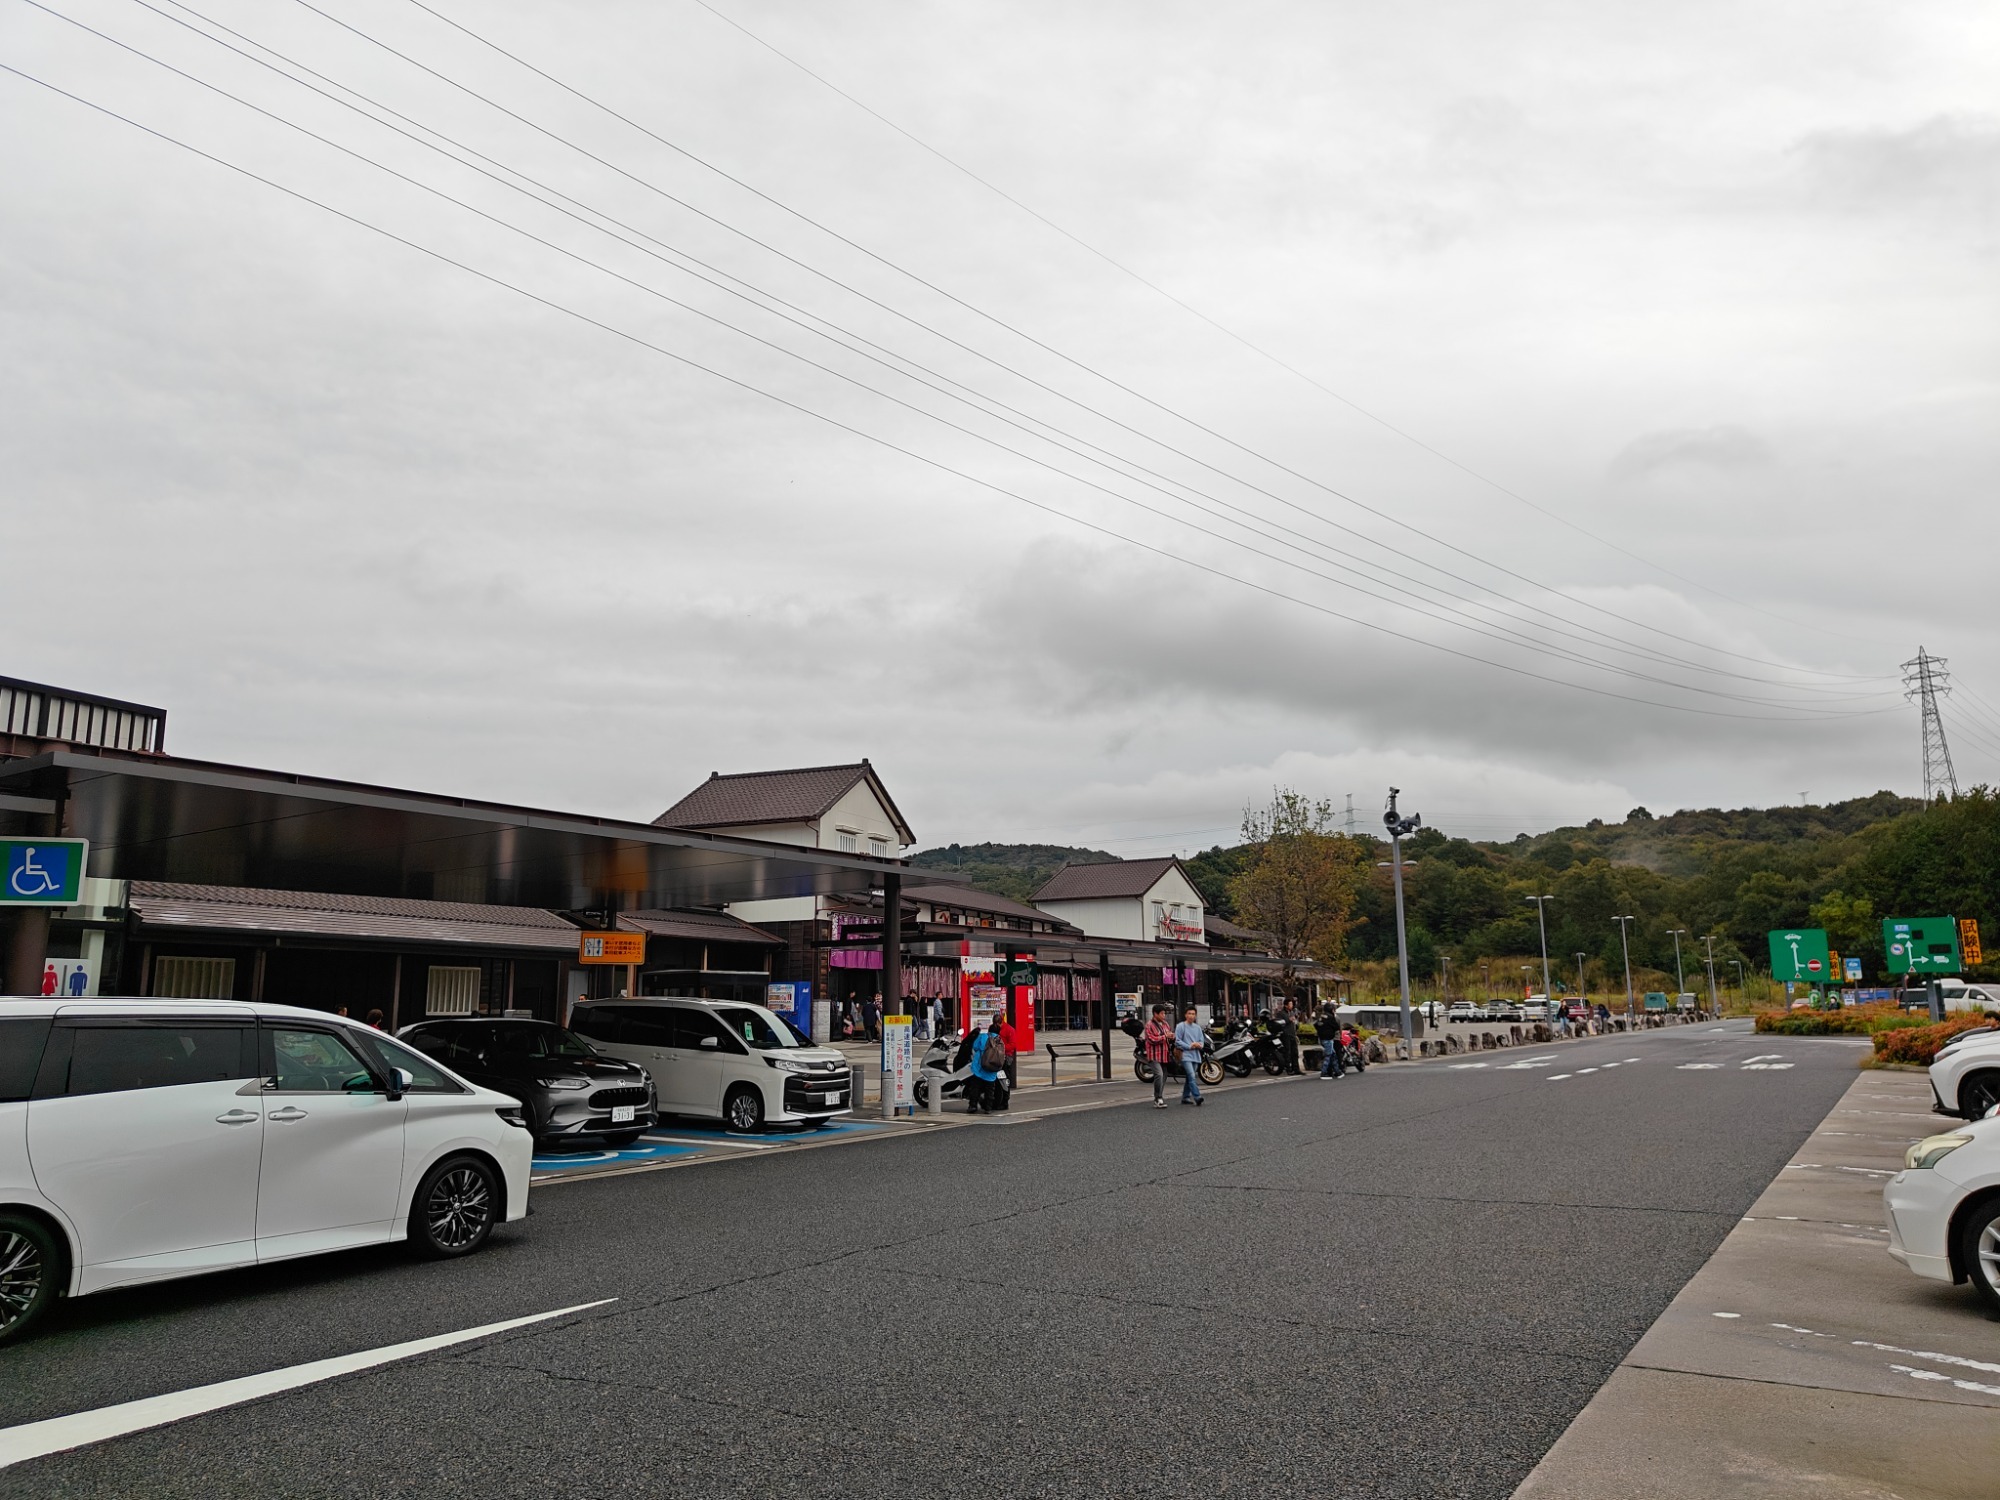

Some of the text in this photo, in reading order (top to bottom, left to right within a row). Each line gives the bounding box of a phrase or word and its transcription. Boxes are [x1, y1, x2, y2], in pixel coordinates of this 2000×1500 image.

[1962, 920, 1980, 963] 試験中
[997, 962, 1008, 985] P
